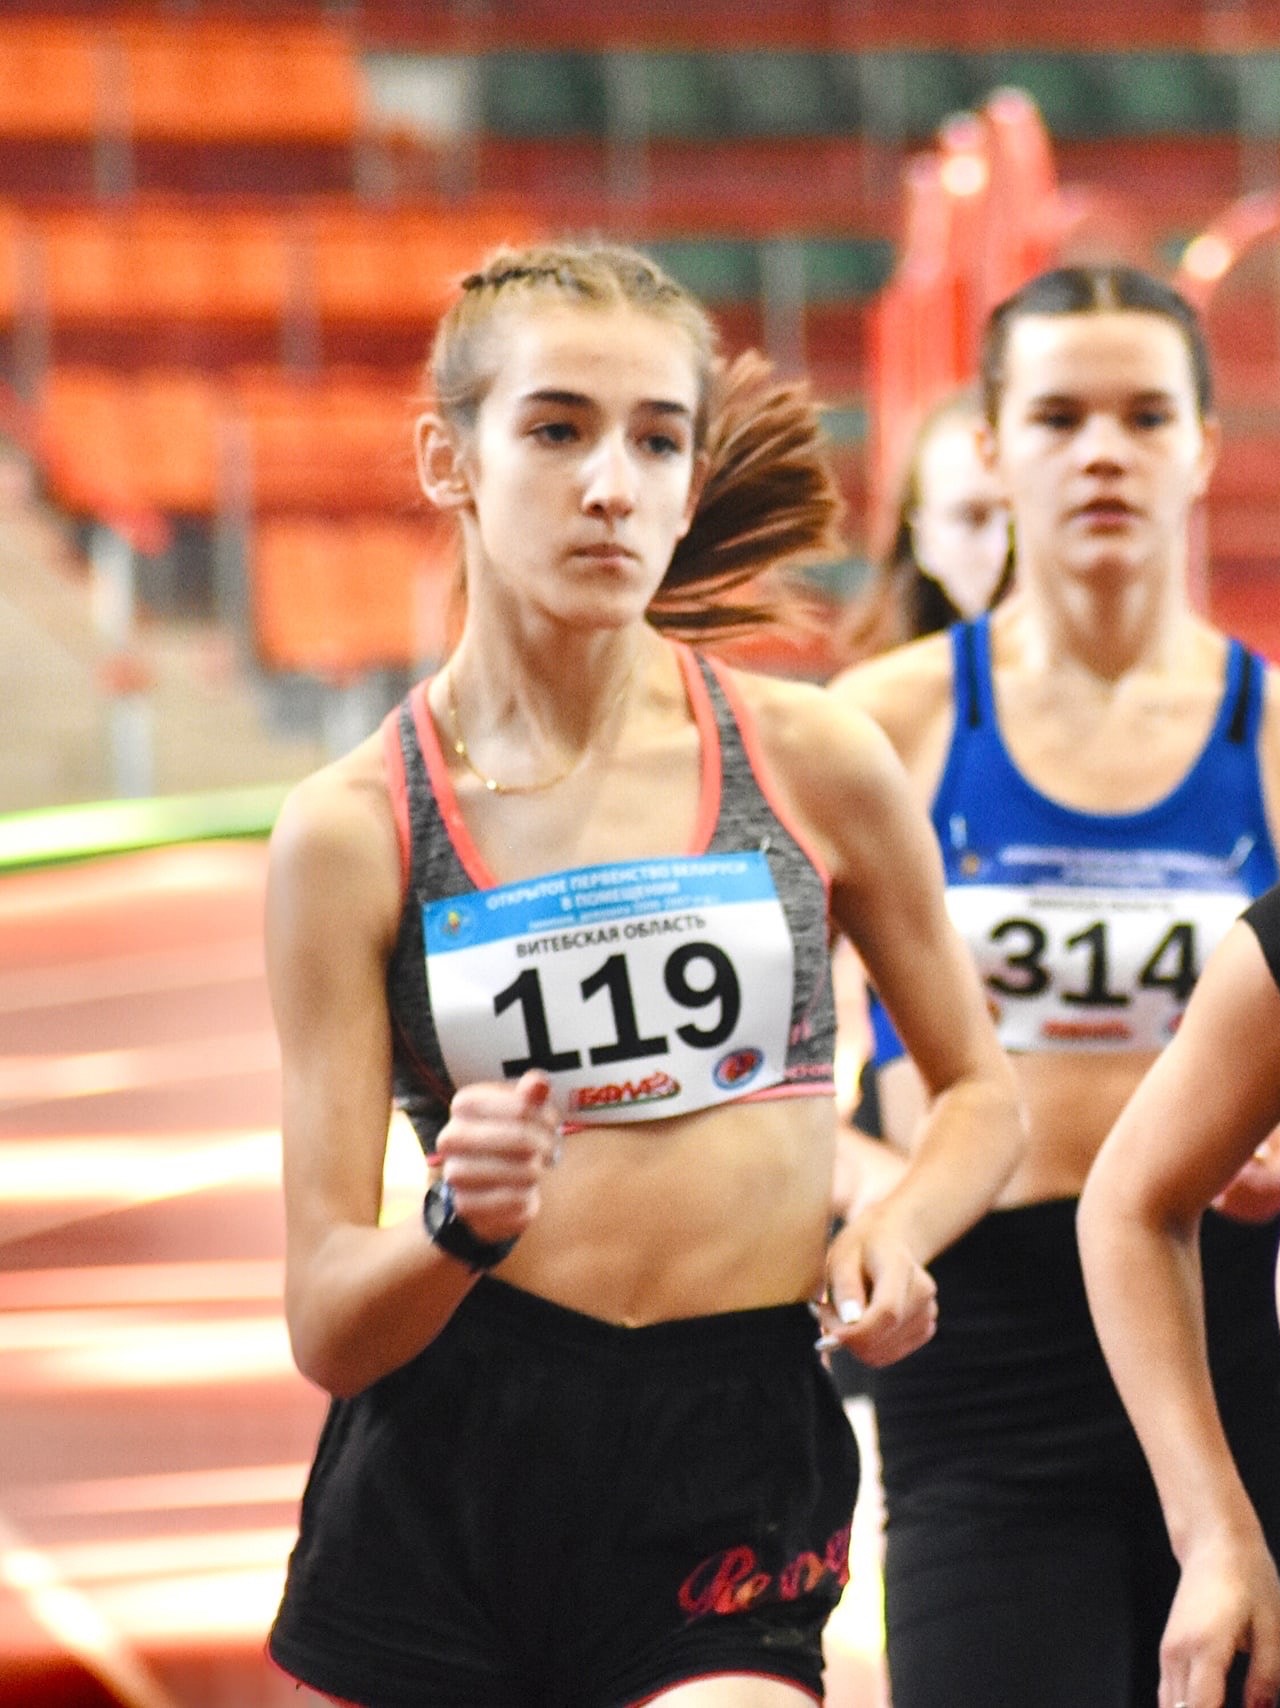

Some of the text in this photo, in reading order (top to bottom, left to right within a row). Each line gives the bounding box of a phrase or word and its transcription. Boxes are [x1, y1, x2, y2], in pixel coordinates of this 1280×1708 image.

[516, 915, 706, 958] ВИТЕБСКАЯ ОБЛАСТЬ
[985, 916, 1198, 1006] 314
[493, 942, 742, 1079] 119
